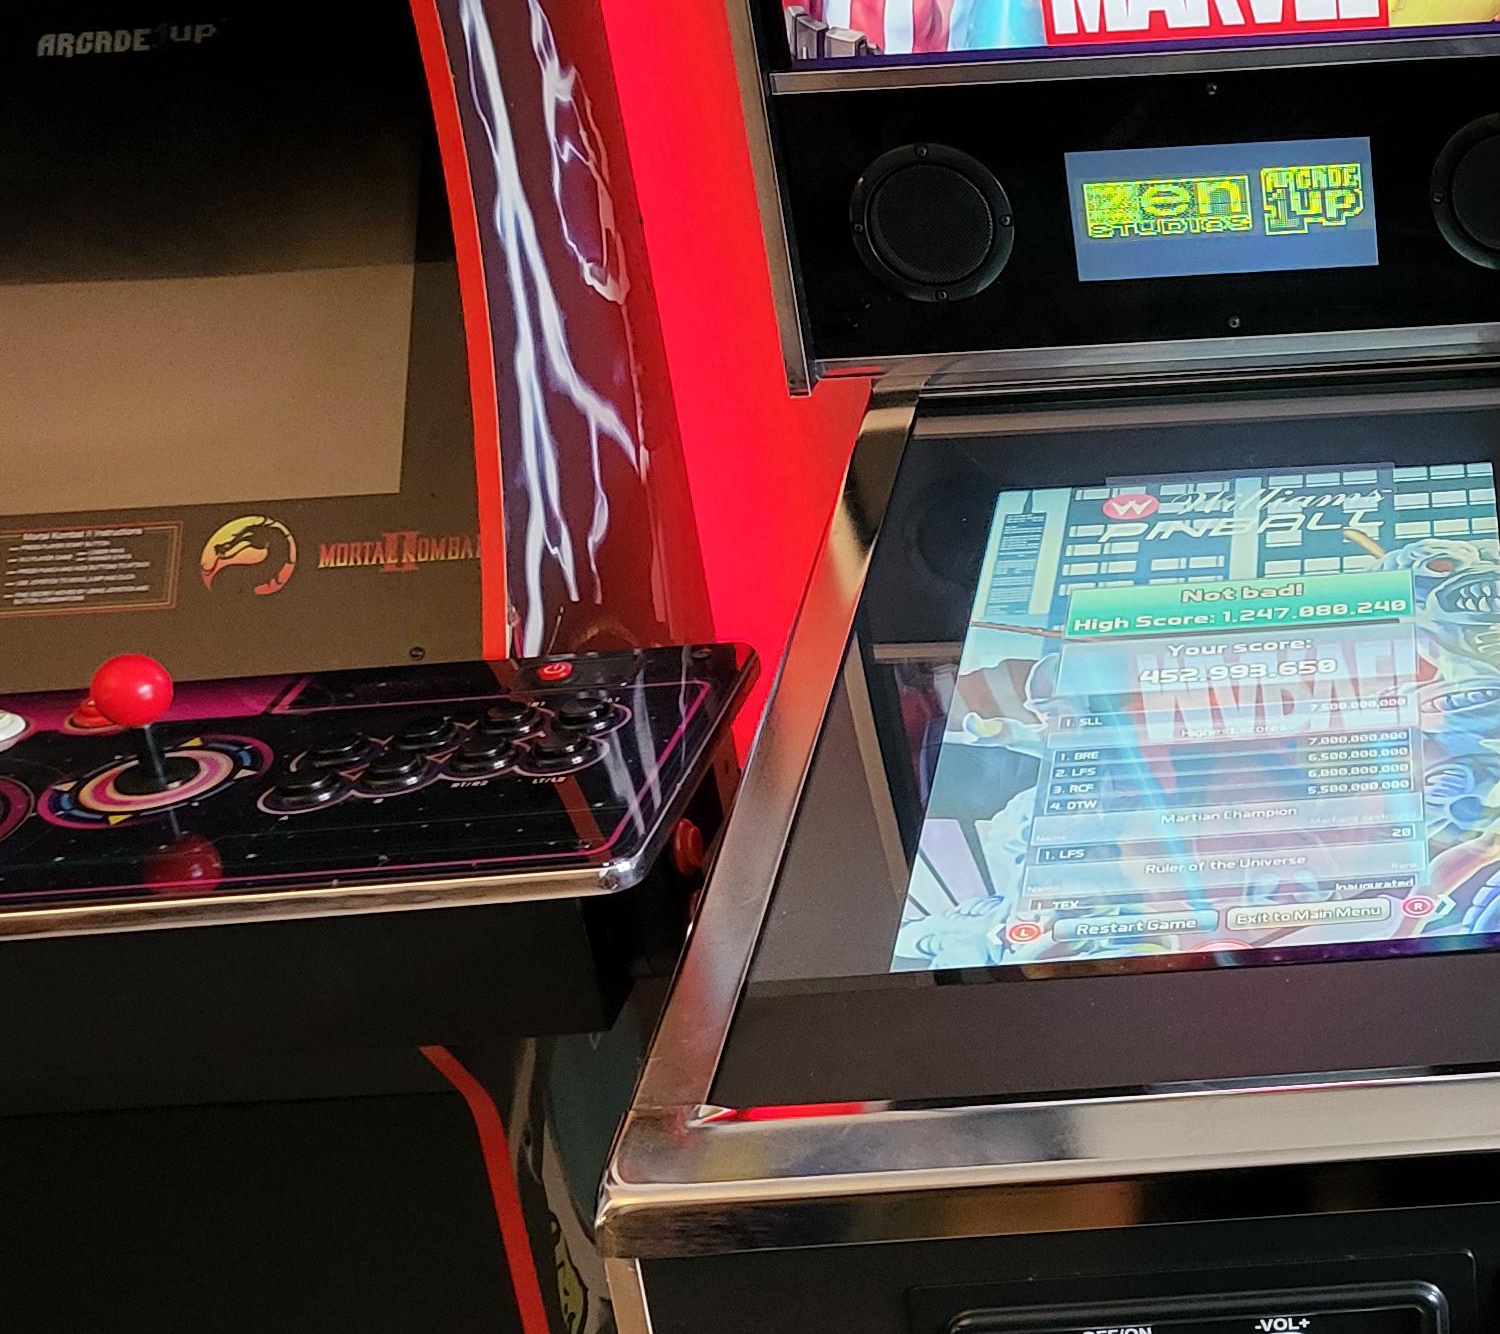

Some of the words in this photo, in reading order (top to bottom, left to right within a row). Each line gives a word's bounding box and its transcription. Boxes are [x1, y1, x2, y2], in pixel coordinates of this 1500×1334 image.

[1264, 165, 1362, 190] ARCADE
[1264, 187, 1364, 235] 1UP
[1088, 216, 1252, 238] STUDIOS
[1099, 510, 1385, 542] PINBALL
[318, 541, 399, 569] MORTAL
[1181, 587, 1233, 603] Not
[1240, 583, 1304, 600] bad!
[1073, 615, 1129, 634] High
[1134, 611, 1216, 628] Score:
[1167, 642, 1230, 657] Your
[1233, 638, 1313, 653] score:
[1066, 799, 1098, 811] DTW
[1160, 811, 1219, 824] Martian
[1223, 805, 1298, 822] Champion
[1145, 861, 1184, 875] Ruler
[1187, 860, 1206, 872] of
[1209, 858, 1236, 871] the
[1239, 854, 1306, 870] Universe
[1236, 911, 1269, 926] Exit
[1271, 910, 1291, 923] to
[1293, 908, 1332, 923] Main
[1335, 904, 1383, 919] Menu
[1076, 919, 1145, 937] Restart
[1146, 917, 1197, 932] Game
